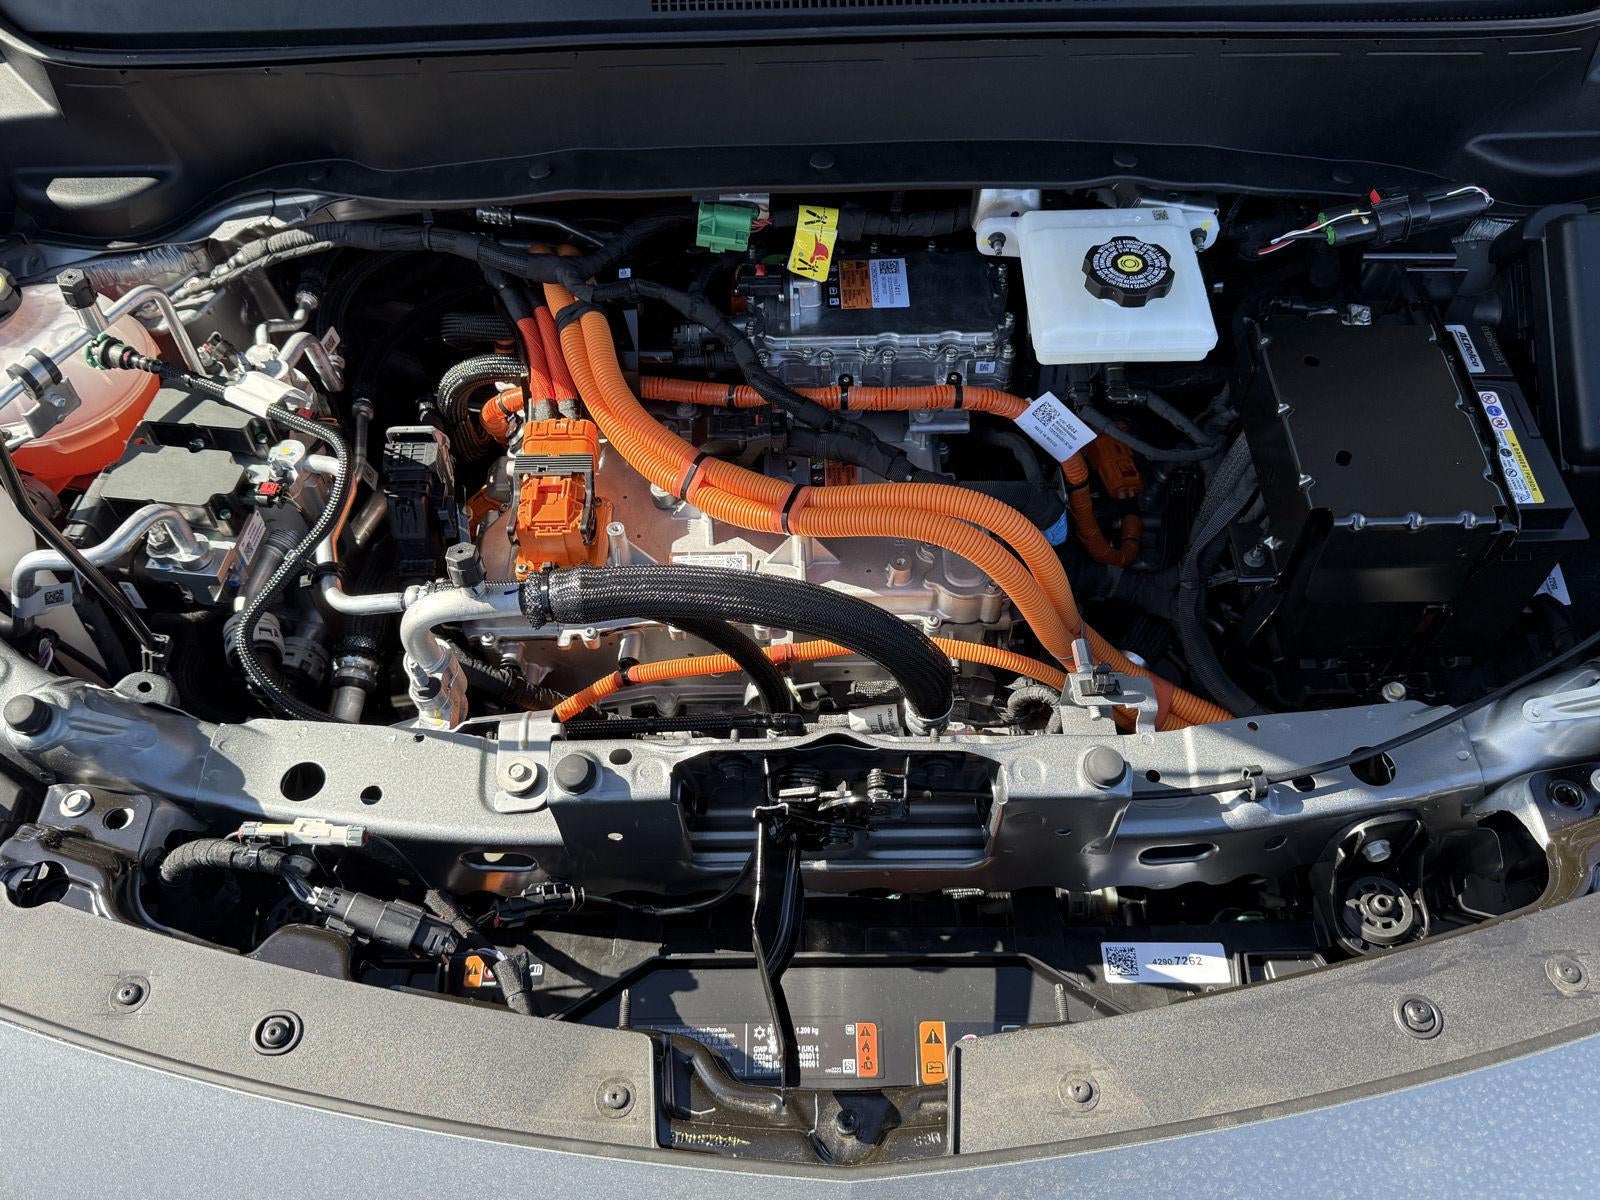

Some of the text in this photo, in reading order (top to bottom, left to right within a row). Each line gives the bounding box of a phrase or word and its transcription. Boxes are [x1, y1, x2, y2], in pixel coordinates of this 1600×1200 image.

[1458, 331, 1480, 368] ACDelco
[1174, 956, 1203, 966] 7262
[811, 1026, 819, 1036] kg
